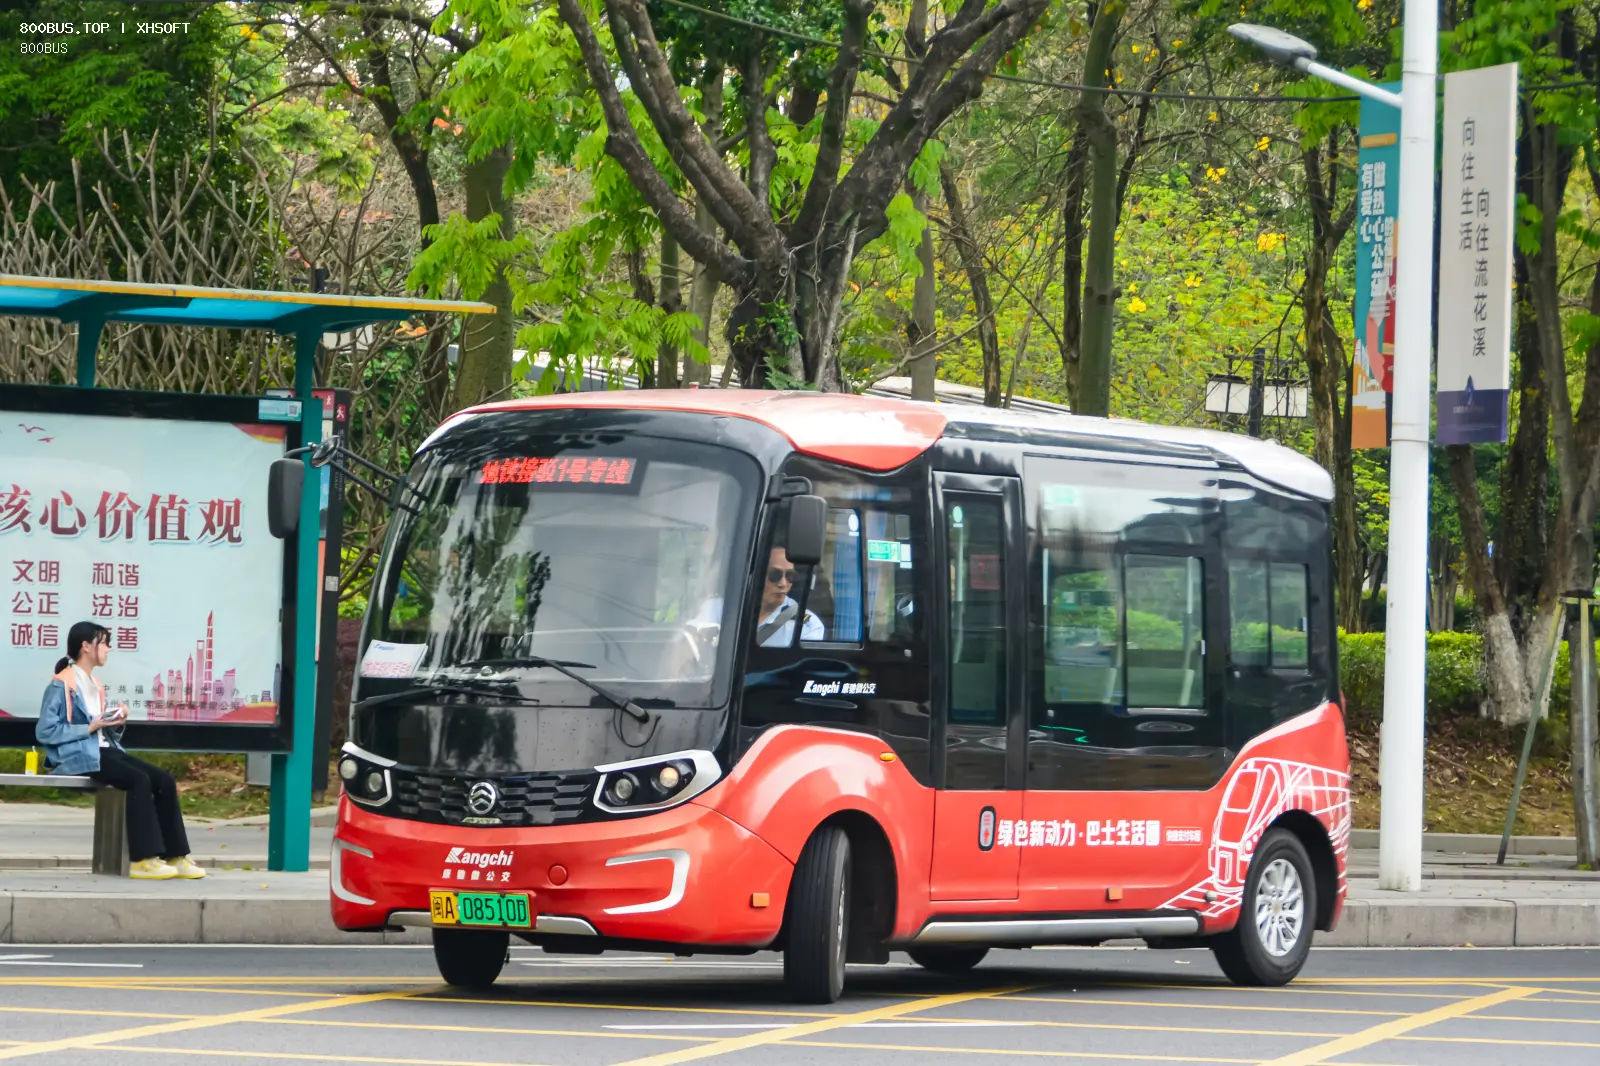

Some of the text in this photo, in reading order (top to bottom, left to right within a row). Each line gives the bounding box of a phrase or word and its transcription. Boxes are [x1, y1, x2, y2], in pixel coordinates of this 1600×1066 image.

[1459, 117, 1475, 250] 向往生活
[1472, 188, 1490, 356] 向往流花溪
[12, 559, 140, 587] 文明 和谐
[12, 591, 139, 618] 公正 法治
[11, 623, 138, 650] 诚信 善
[803, 680, 840, 696] Kangchi
[444, 847, 514, 868] Kangchi
